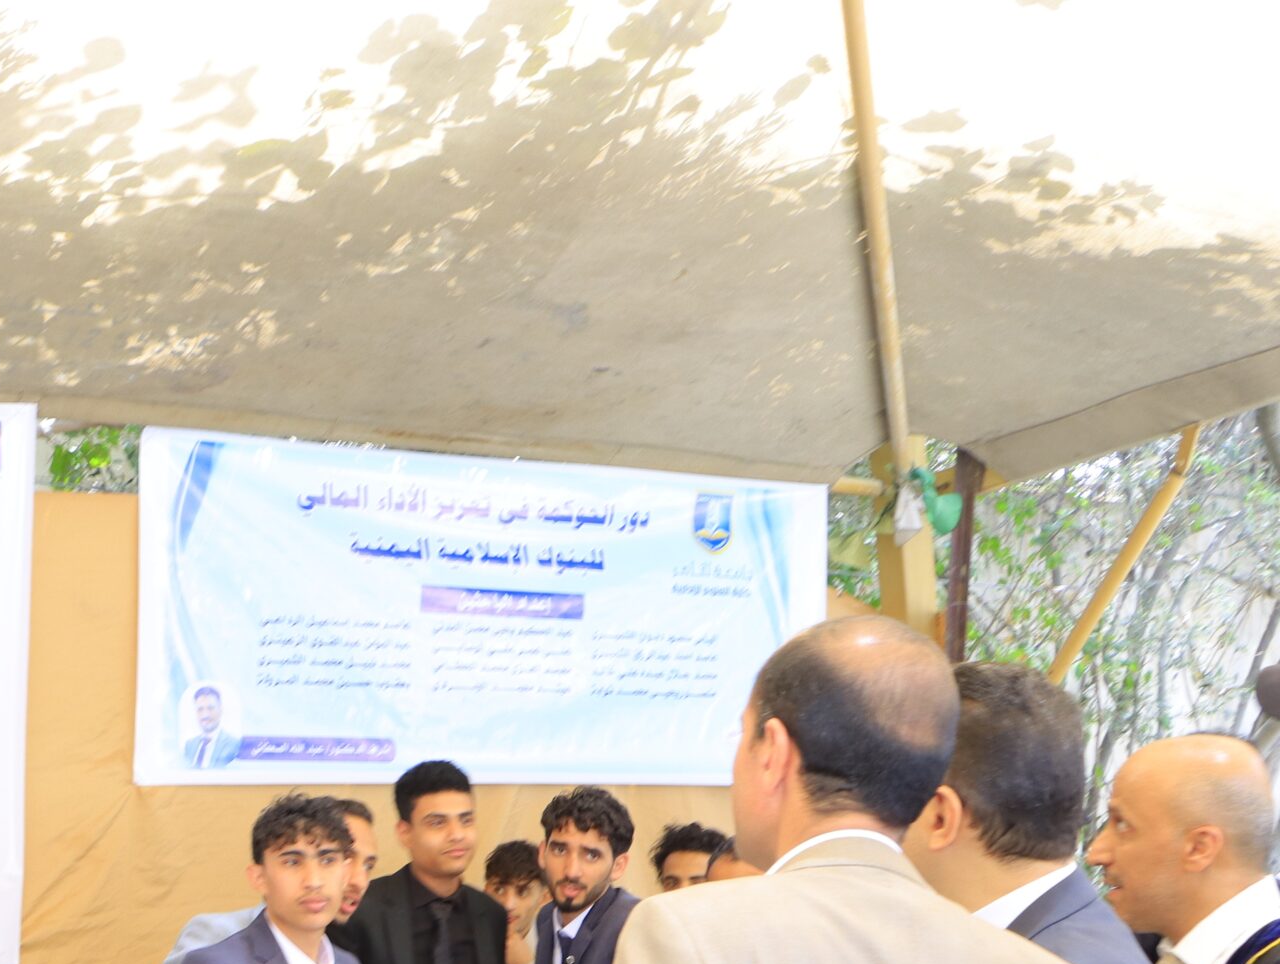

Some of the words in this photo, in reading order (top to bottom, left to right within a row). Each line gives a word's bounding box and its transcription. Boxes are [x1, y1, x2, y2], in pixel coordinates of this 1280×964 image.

[297, 482, 368, 518] المالي
[376, 485, 427, 513] الأداء
[536, 498, 613, 529] الحوكمة
[619, 510, 651, 534] دور
[350, 531, 430, 565] اليمنية
[538, 546, 605, 576] للبنوك
